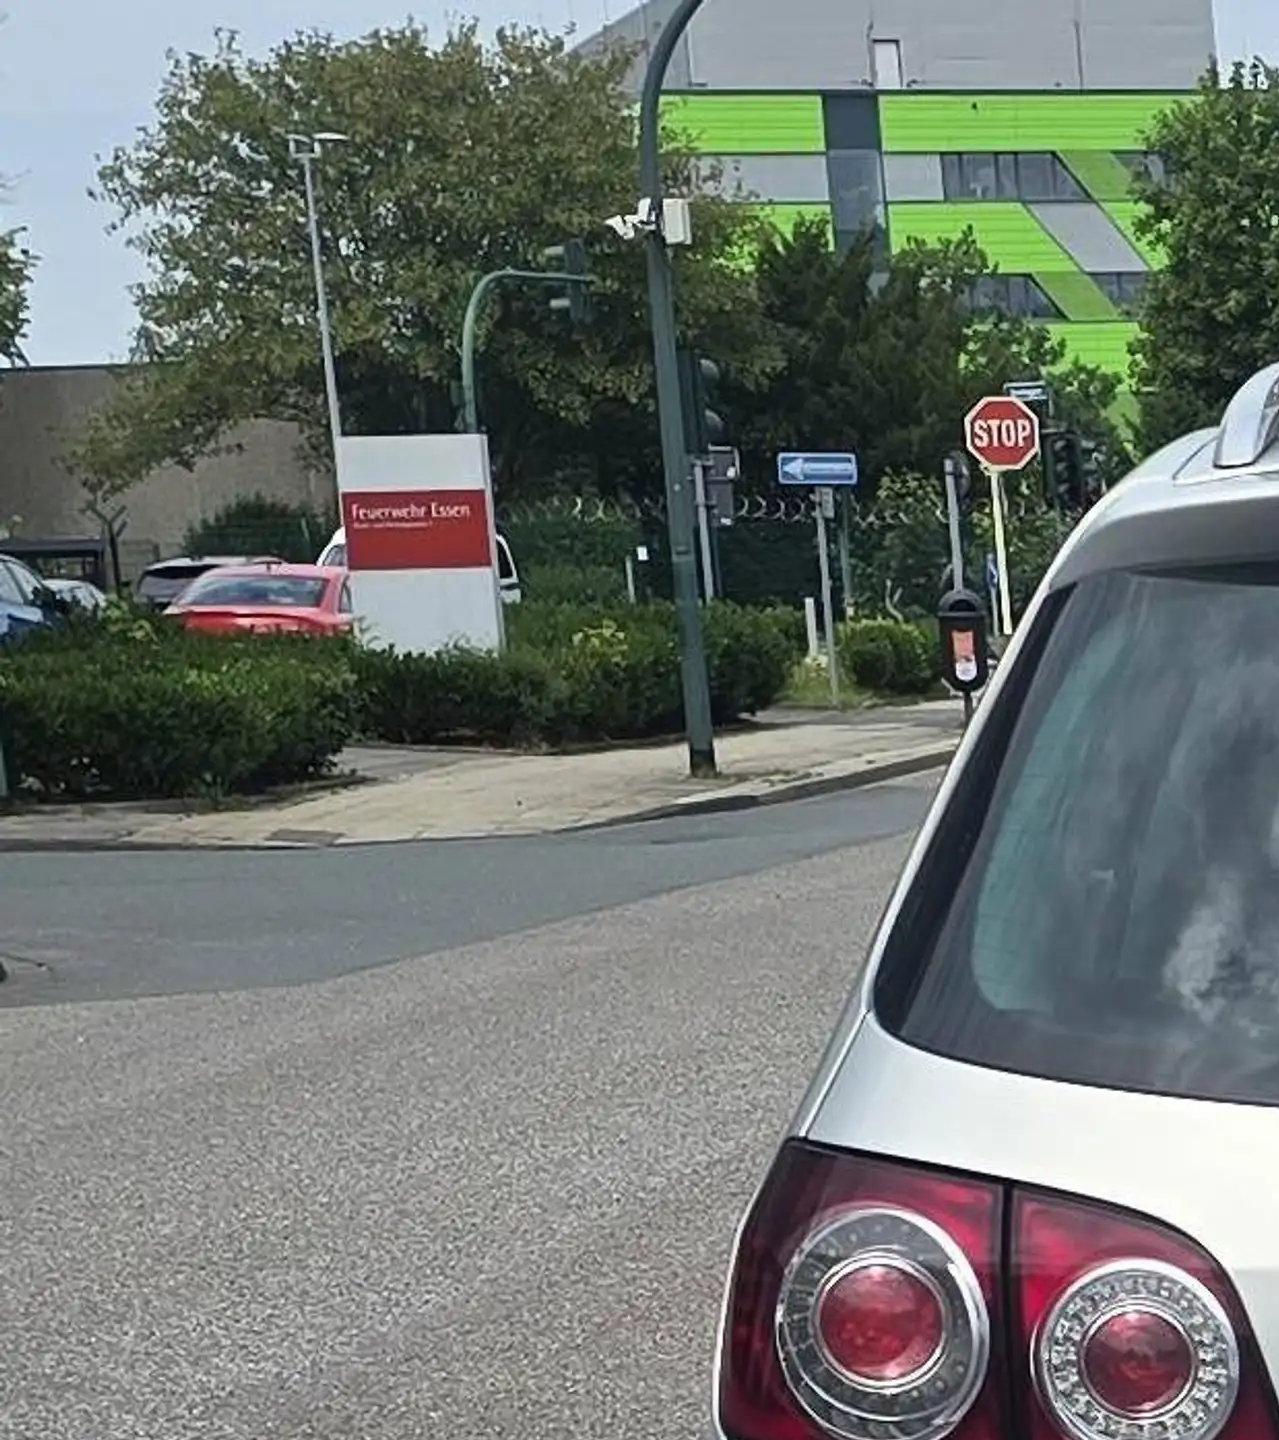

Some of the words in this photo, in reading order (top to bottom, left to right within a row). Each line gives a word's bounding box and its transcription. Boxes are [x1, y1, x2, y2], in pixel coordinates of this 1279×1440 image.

[973, 419, 1031, 447] STOP
[352, 503, 426, 520] Feuerwehr
[431, 502, 470, 517] Essen
